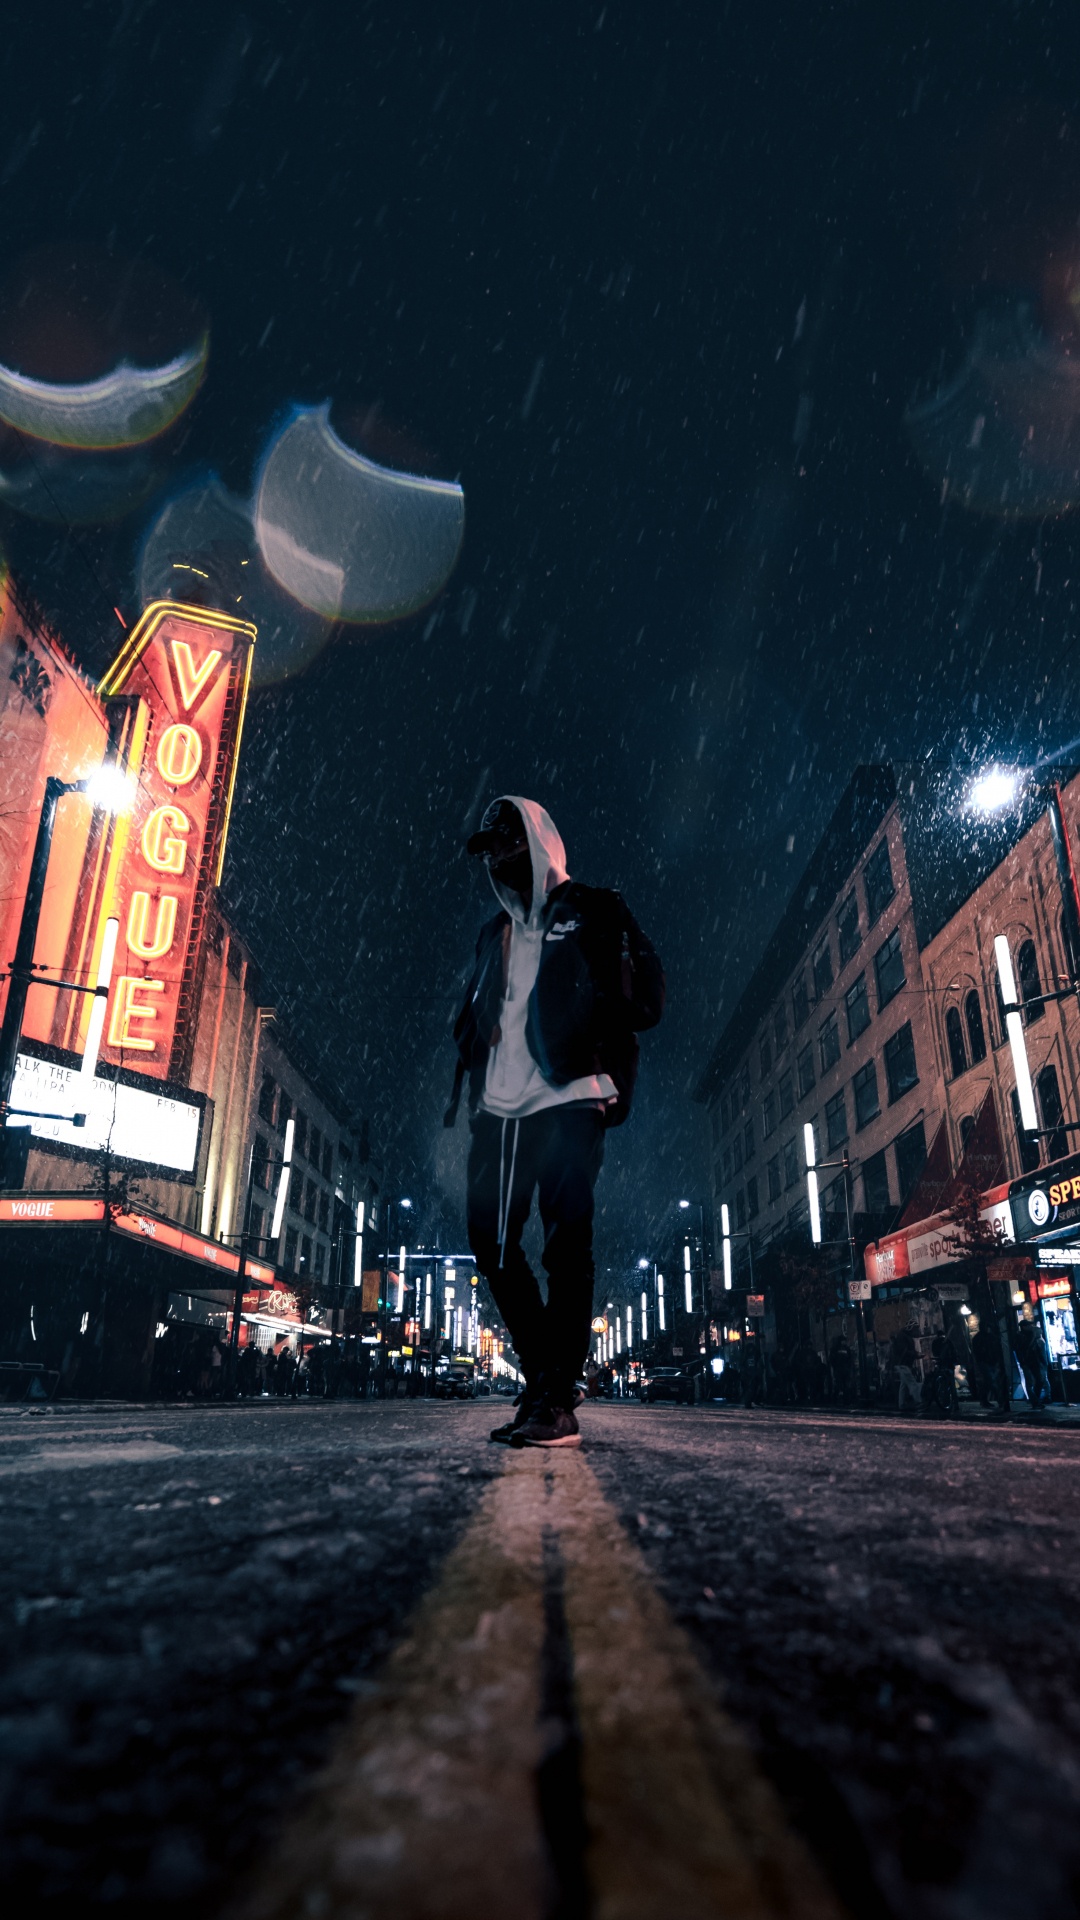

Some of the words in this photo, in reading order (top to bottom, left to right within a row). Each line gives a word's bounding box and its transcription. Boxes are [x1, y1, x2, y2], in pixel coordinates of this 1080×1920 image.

[106, 639, 222, 1051] VOGUE
[16, 1056, 41, 1073] ALK
[49, 1066, 73, 1082] THE
[187, 1107, 197, 1118] 15
[11, 1202, 55, 1217] VOGUE
